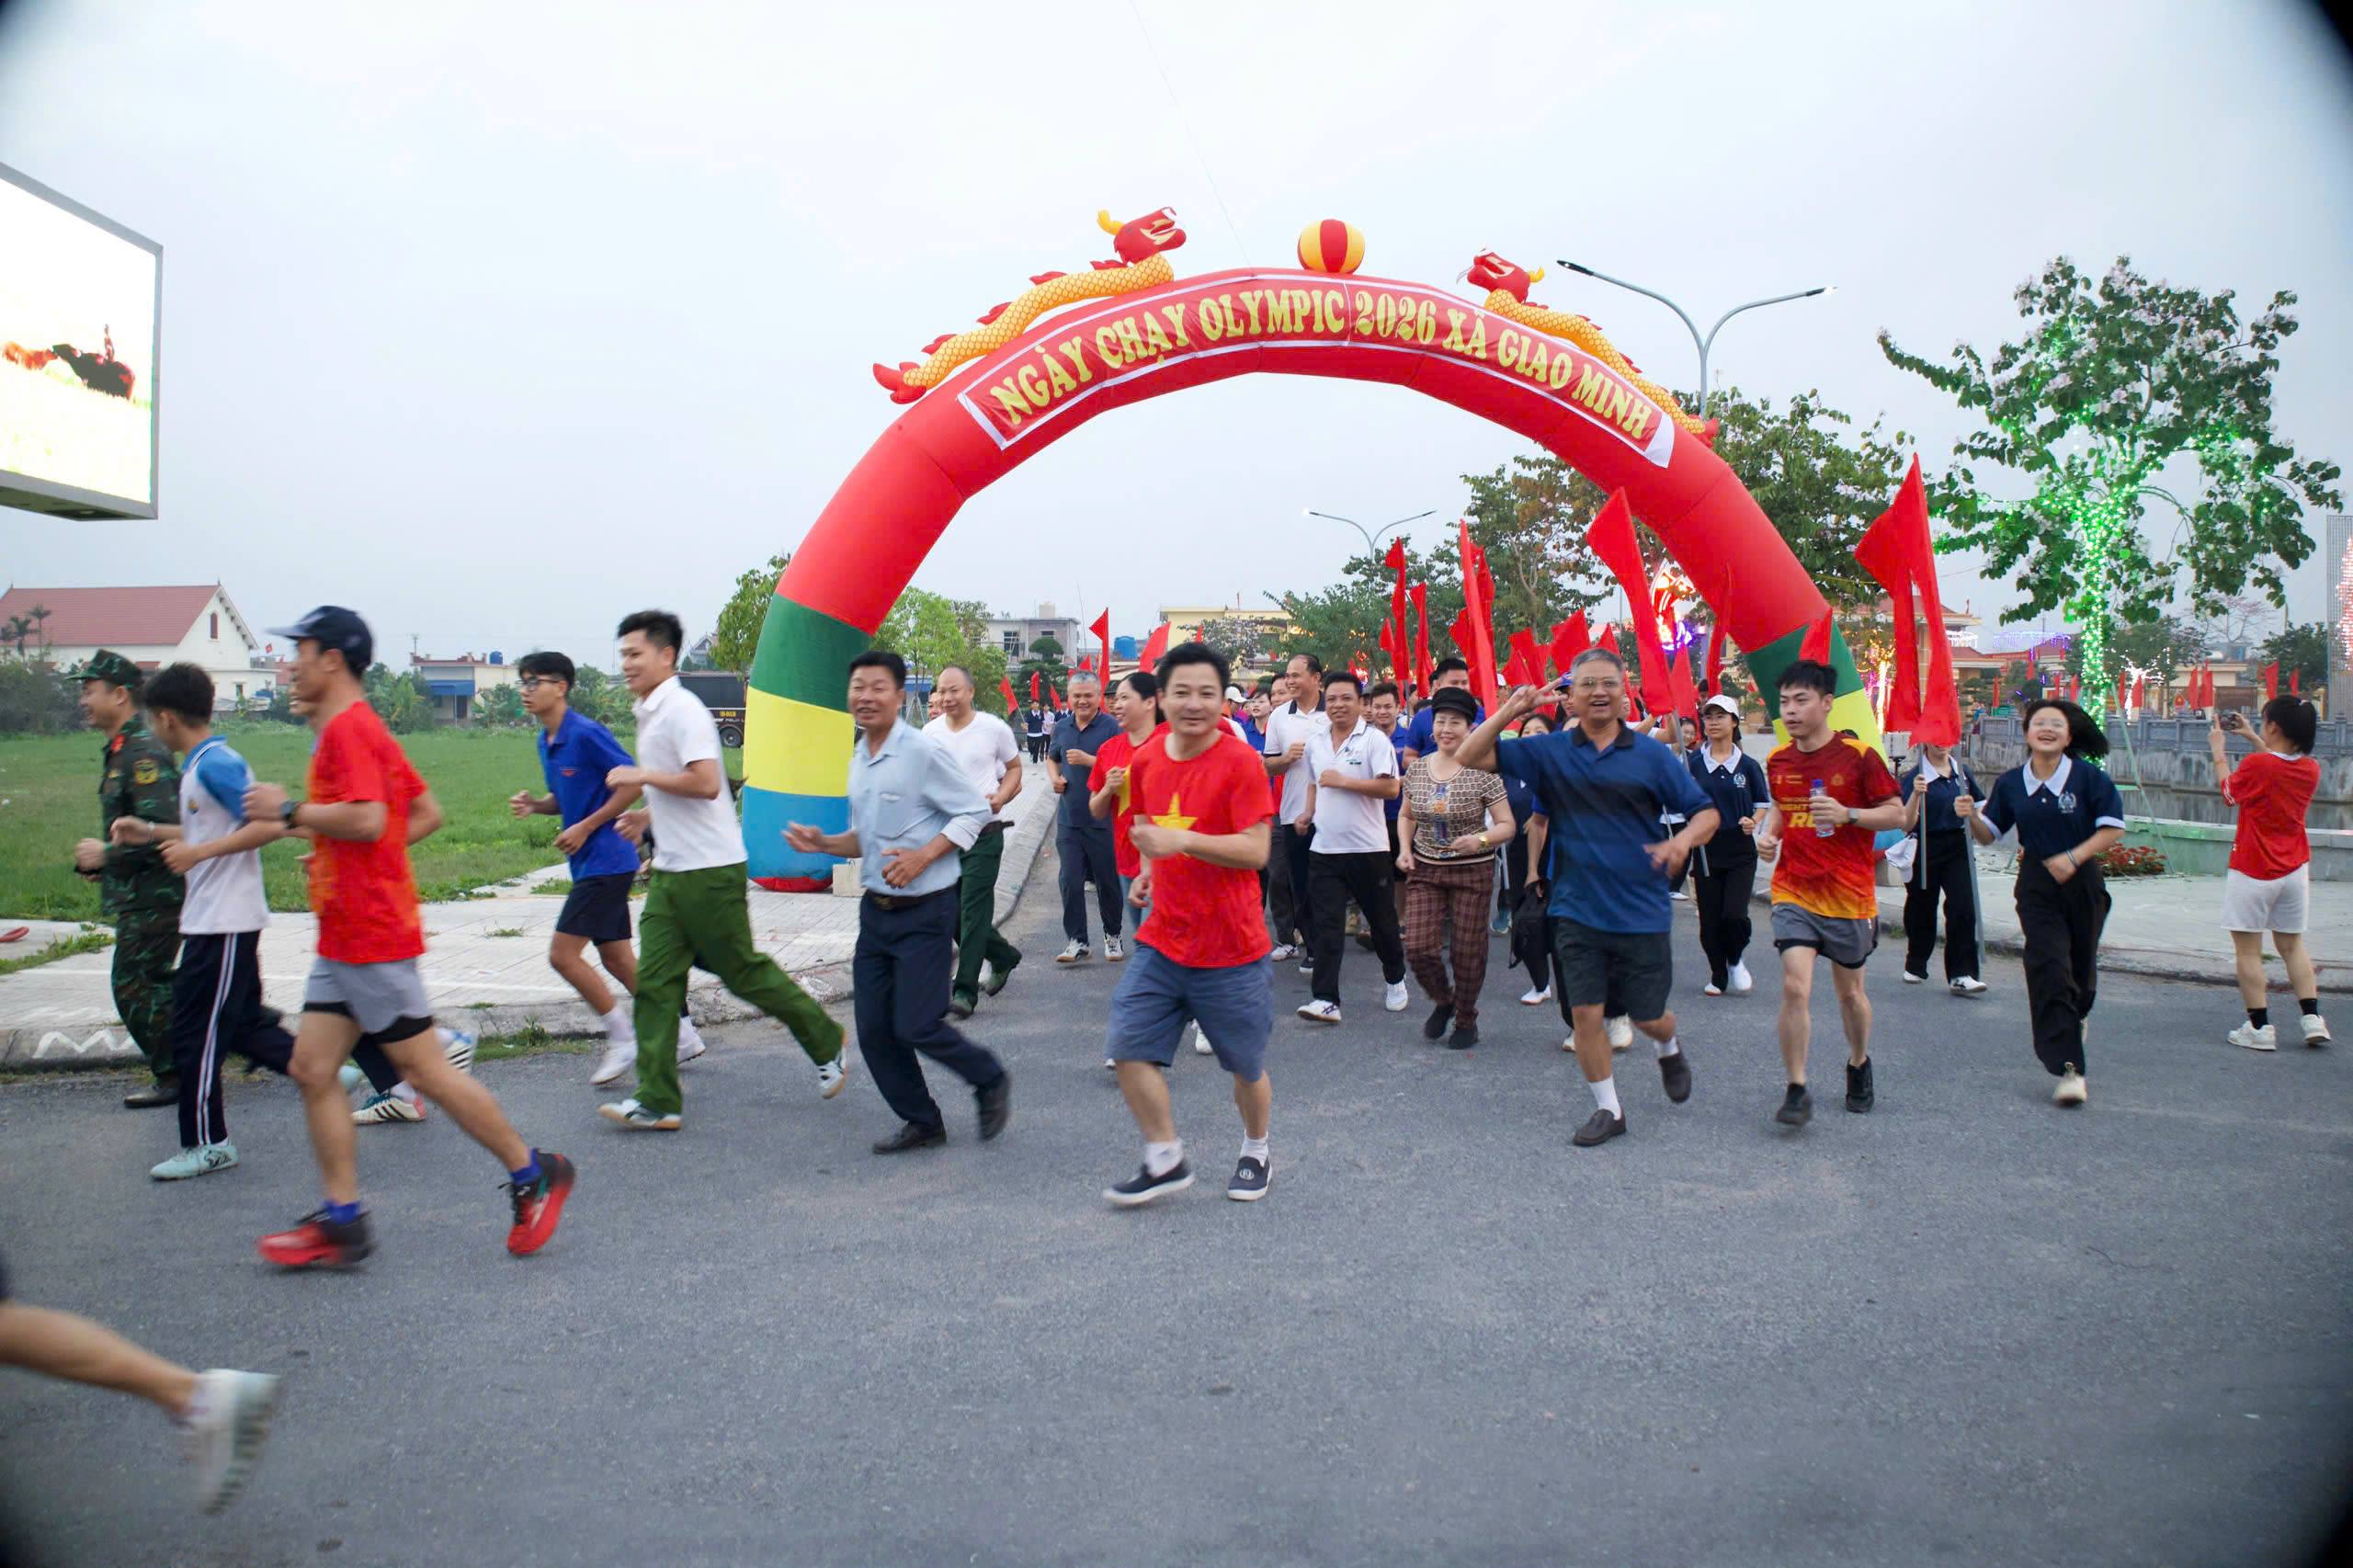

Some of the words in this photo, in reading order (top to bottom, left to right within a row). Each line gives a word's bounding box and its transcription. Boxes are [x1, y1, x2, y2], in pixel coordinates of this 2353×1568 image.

[991, 335, 1093, 425] NGÀY
[1096, 302, 1190, 367] CHẠY
[1198, 290, 1345, 342] OLYMPIC
[1354, 290, 1437, 345] 2026
[1497, 330, 1573, 391] GIAO
[1572, 363, 1653, 439] MINH
